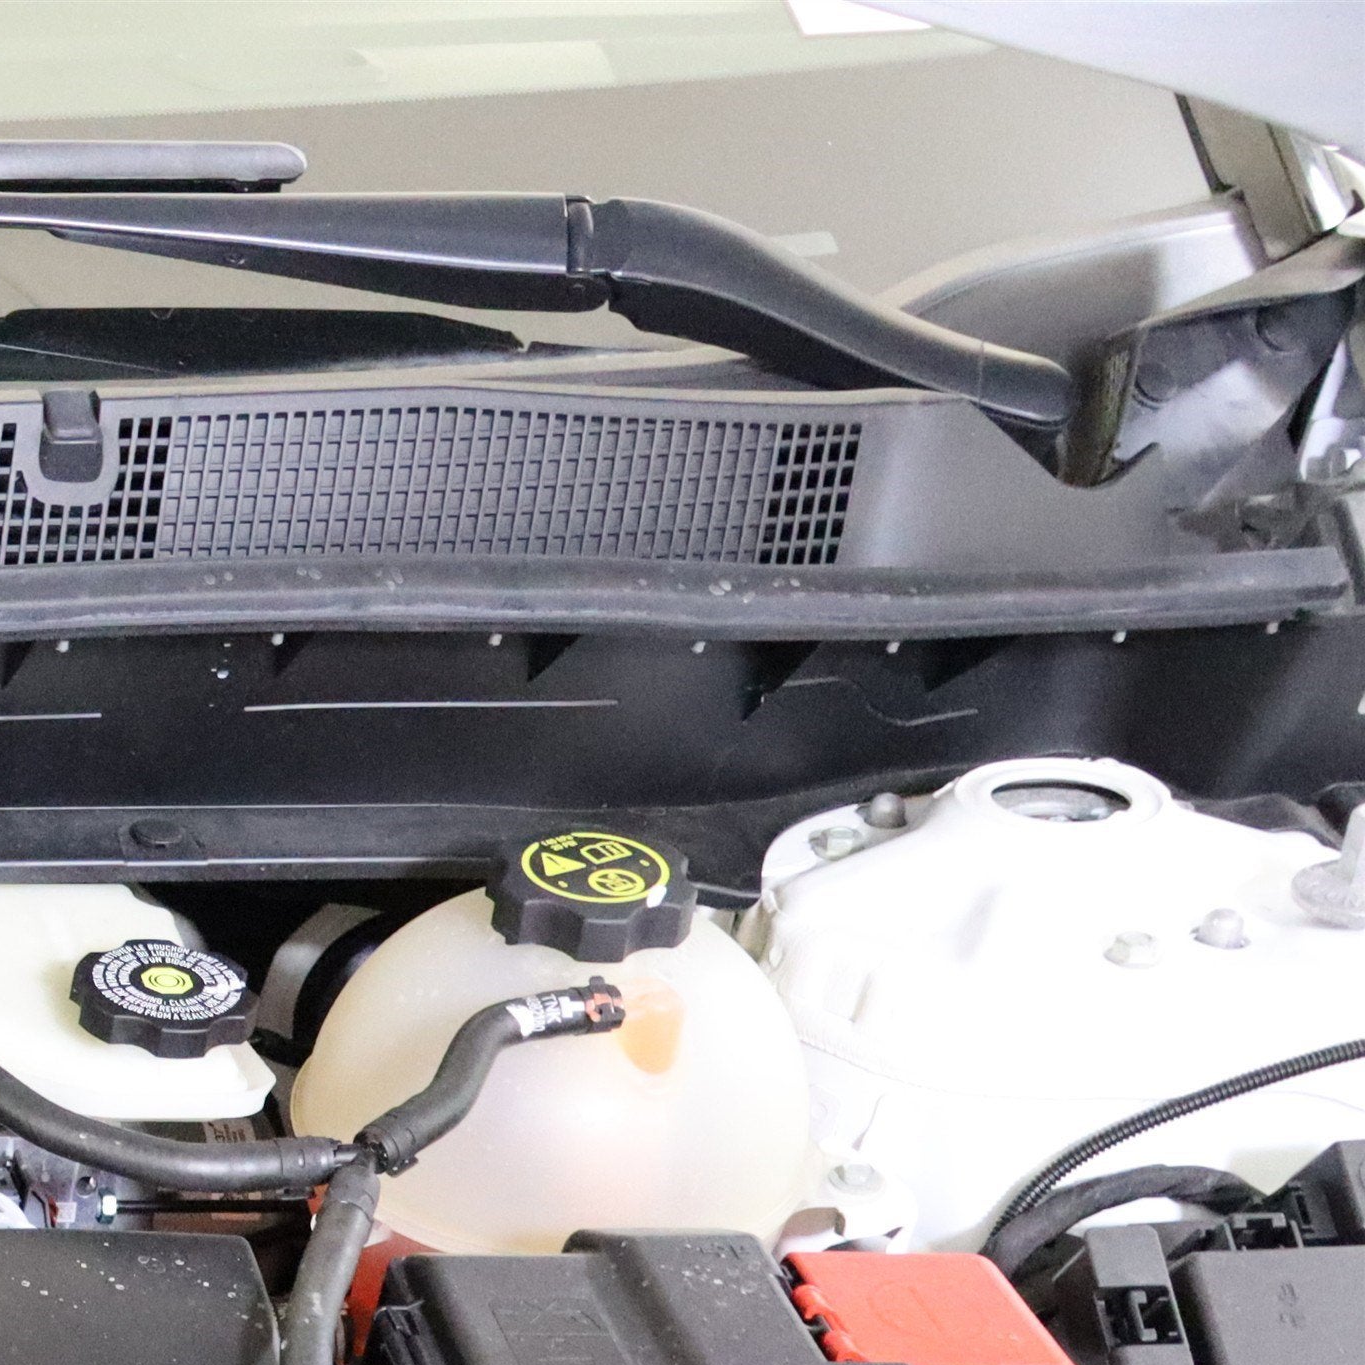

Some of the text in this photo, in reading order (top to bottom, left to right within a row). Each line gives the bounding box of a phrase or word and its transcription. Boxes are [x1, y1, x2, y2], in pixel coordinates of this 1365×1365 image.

[147, 943, 190, 954] BOUCHON
[152, 950, 186, 961] LIQUIDE
[145, 1010, 172, 1020] FROM
